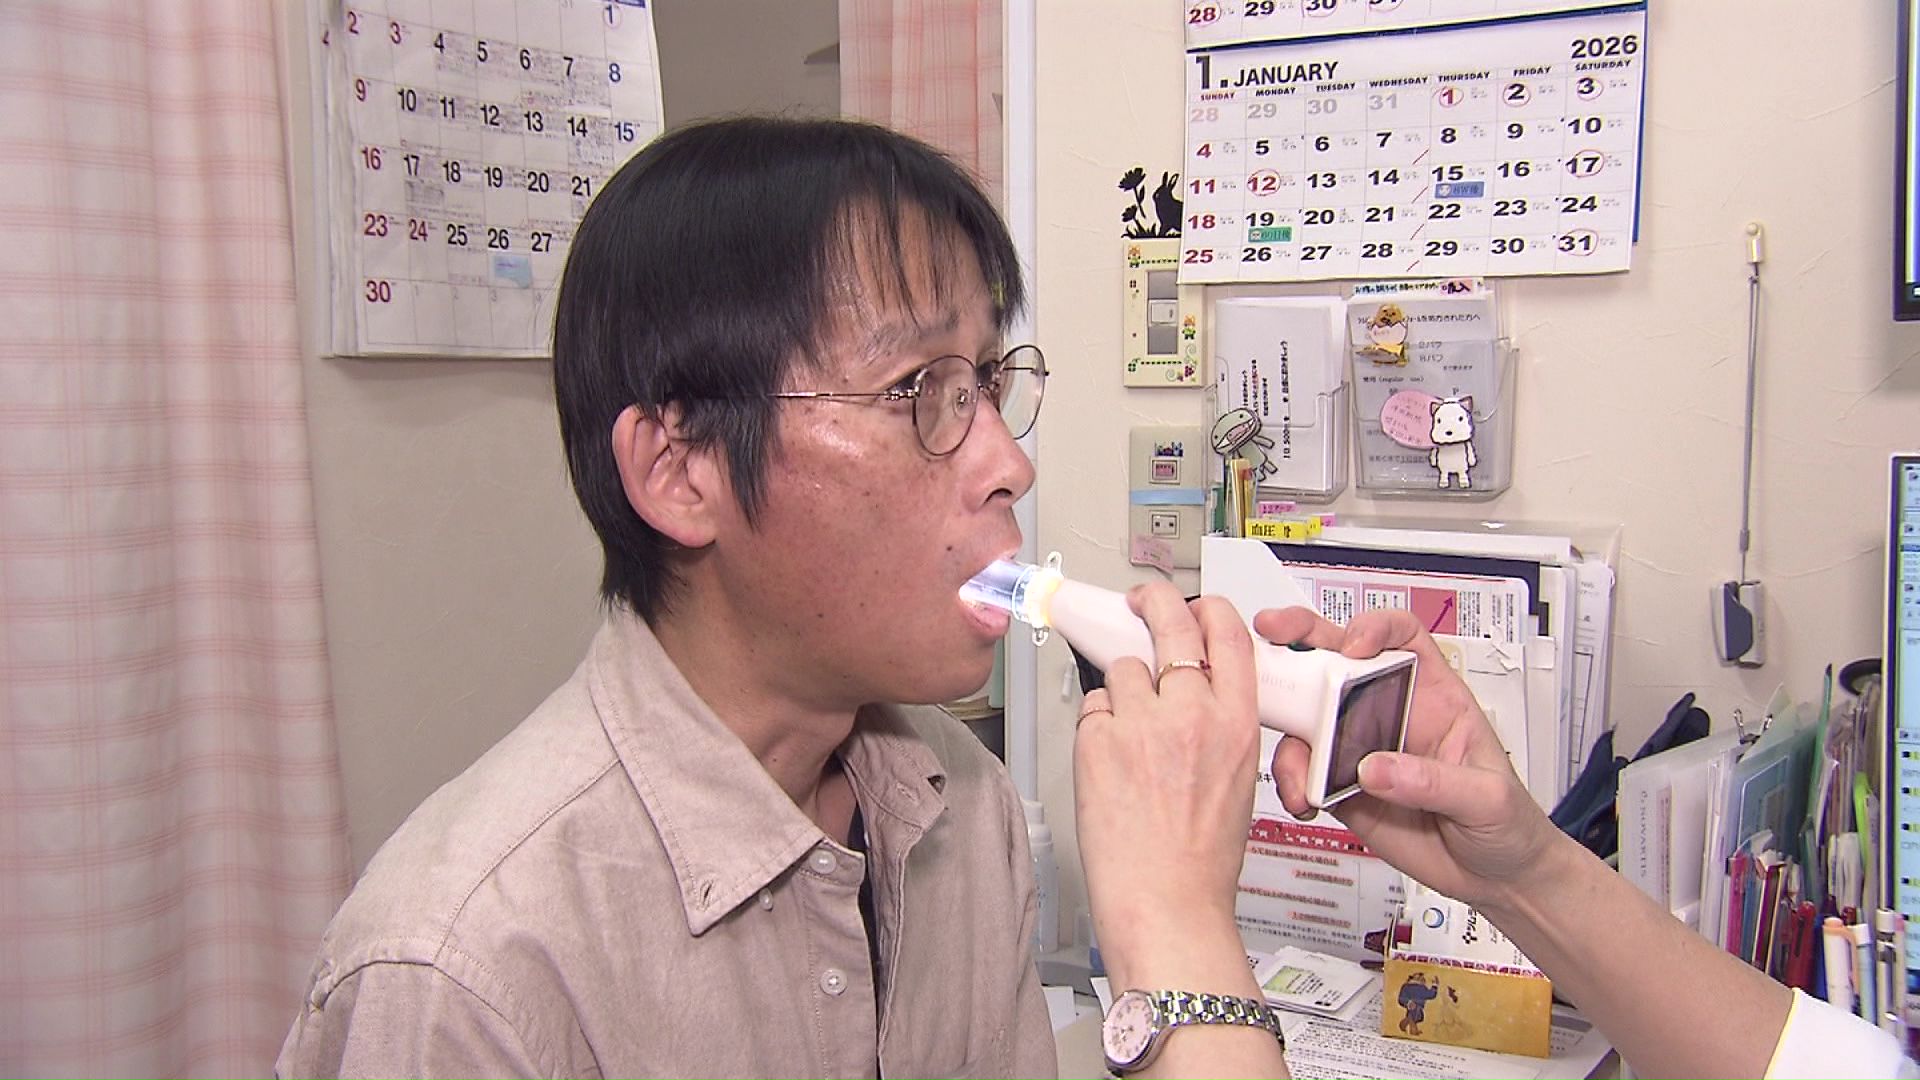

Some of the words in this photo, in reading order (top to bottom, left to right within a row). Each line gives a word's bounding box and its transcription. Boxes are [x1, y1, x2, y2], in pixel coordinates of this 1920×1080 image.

[605, 5, 614, 24] 1
[1189, 7, 1216, 24] 28
[1244, 0, 1275, 17] 29
[348, 12, 359, 34] 2
[390, 23, 402, 44] 3
[434, 33, 445, 53] 4
[477, 42, 488, 62] 5
[520, 50, 531, 70] 6
[563, 57, 574, 78] 7
[608, 63, 621, 83] 8
[1571, 35, 1638, 59] 2026
[1201, 92, 1235, 101] SUNDAY
[1255, 87, 1296, 97] MONDAY
[1316, 82, 1356, 92] TUESDAY
[1369, 76, 1428, 88] WEDNESDAY
[1438, 71, 1490, 82] THURSDAY
[1513, 66, 1551, 77] FRIDAY
[1575, 60, 1631, 71] SATURDAY
[1233, 61, 1339, 88] JANUARY
[356, 80, 367, 101] 9
[398, 89, 417, 112] 10
[440, 97, 456, 119] 11
[480, 106, 500, 126] 12
[524, 111, 544, 132] 13
[568, 117, 588, 137] 14
[614, 122, 634, 142] 15
[1191, 108, 1219, 122] 28
[1248, 103, 1277, 119] 29
[1308, 99, 1337, 115] 30
[1369, 94, 1398, 110] 31
[1441, 89, 1453, 104] 1
[1507, 83, 1525, 100] 2
[1577, 77, 1595, 94] 3
[1197, 143, 1212, 159] 4
[1255, 140, 1269, 155] 5
[1315, 136, 1329, 151] 6
[1376, 132, 1392, 147] 7
[1440, 127, 1456, 143] 8
[1507, 123, 1524, 139] 9
[1568, 117, 1602, 134] 10
[361, 148, 381, 170] 16
[404, 155, 420, 176] 17
[443, 162, 461, 183] 18
[484, 167, 503, 188] 19
[528, 173, 549, 193] 20
[572, 177, 592, 197] 21
[1189, 179, 1216, 194] 11
[1248, 176, 1277, 192] 12
[1307, 173, 1337, 188] 13
[1368, 169, 1400, 185] 14
[1432, 165, 1463, 181] 15
[1497, 161, 1530, 178] 16
[1565, 157, 1600, 174] 17
[1188, 215, 1216, 230] 18
[1246, 212, 1274, 227] 19
[1304, 210, 1335, 225] 20
[1365, 207, 1395, 222] 21
[1428, 203, 1461, 219] 22
[1493, 200, 1527, 216] 23
[1562, 196, 1597, 213] 24
[364, 215, 389, 237] 23
[409, 220, 428, 242] 24
[447, 225, 468, 246] 25
[488, 229, 509, 249] 26
[531, 233, 552, 253] 27
[1184, 249, 1214, 264] 25
[1242, 247, 1272, 262] 26
[1301, 245, 1332, 260] 27
[1361, 243, 1393, 258] 28
[1425, 241, 1458, 256] 29
[1491, 238, 1525, 254] 30
[1558, 235, 1591, 252] 31
[366, 281, 391, 303] 30
[1639, 805, 1648, 878] NOVARTIS
